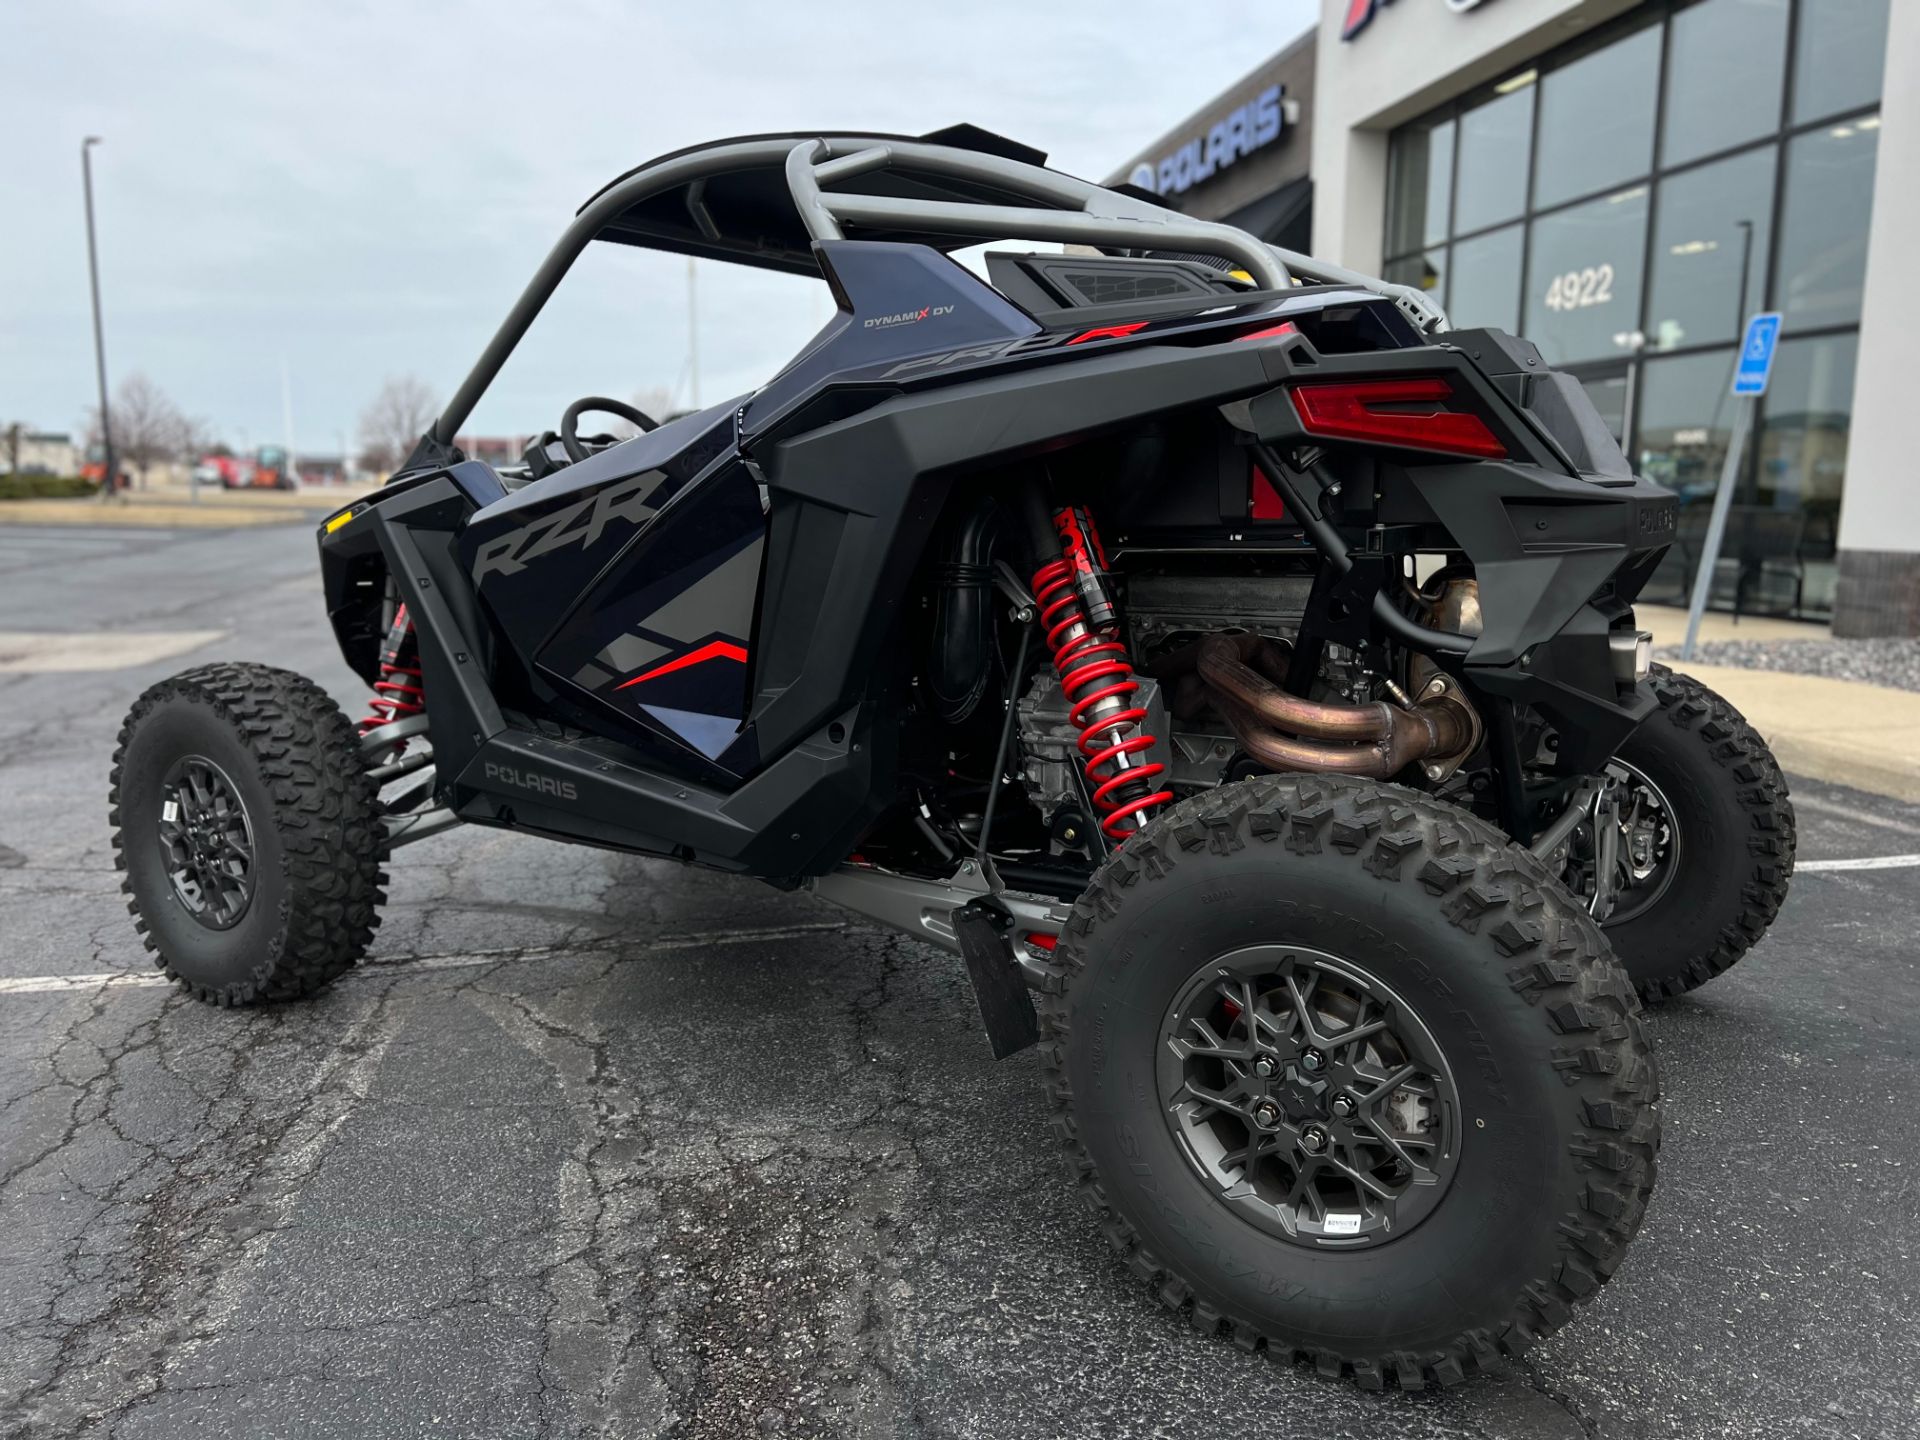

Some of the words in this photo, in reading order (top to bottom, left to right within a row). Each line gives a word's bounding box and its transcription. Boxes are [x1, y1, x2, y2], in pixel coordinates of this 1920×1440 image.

[1158, 84, 1283, 196] POLARIS
[1545, 263, 1614, 311] 4922
[864, 305, 930, 328] DYNAMIX
[933, 305, 955, 316] DV
[472, 469, 668, 587] RZR
[485, 762, 578, 800] POLARIS
